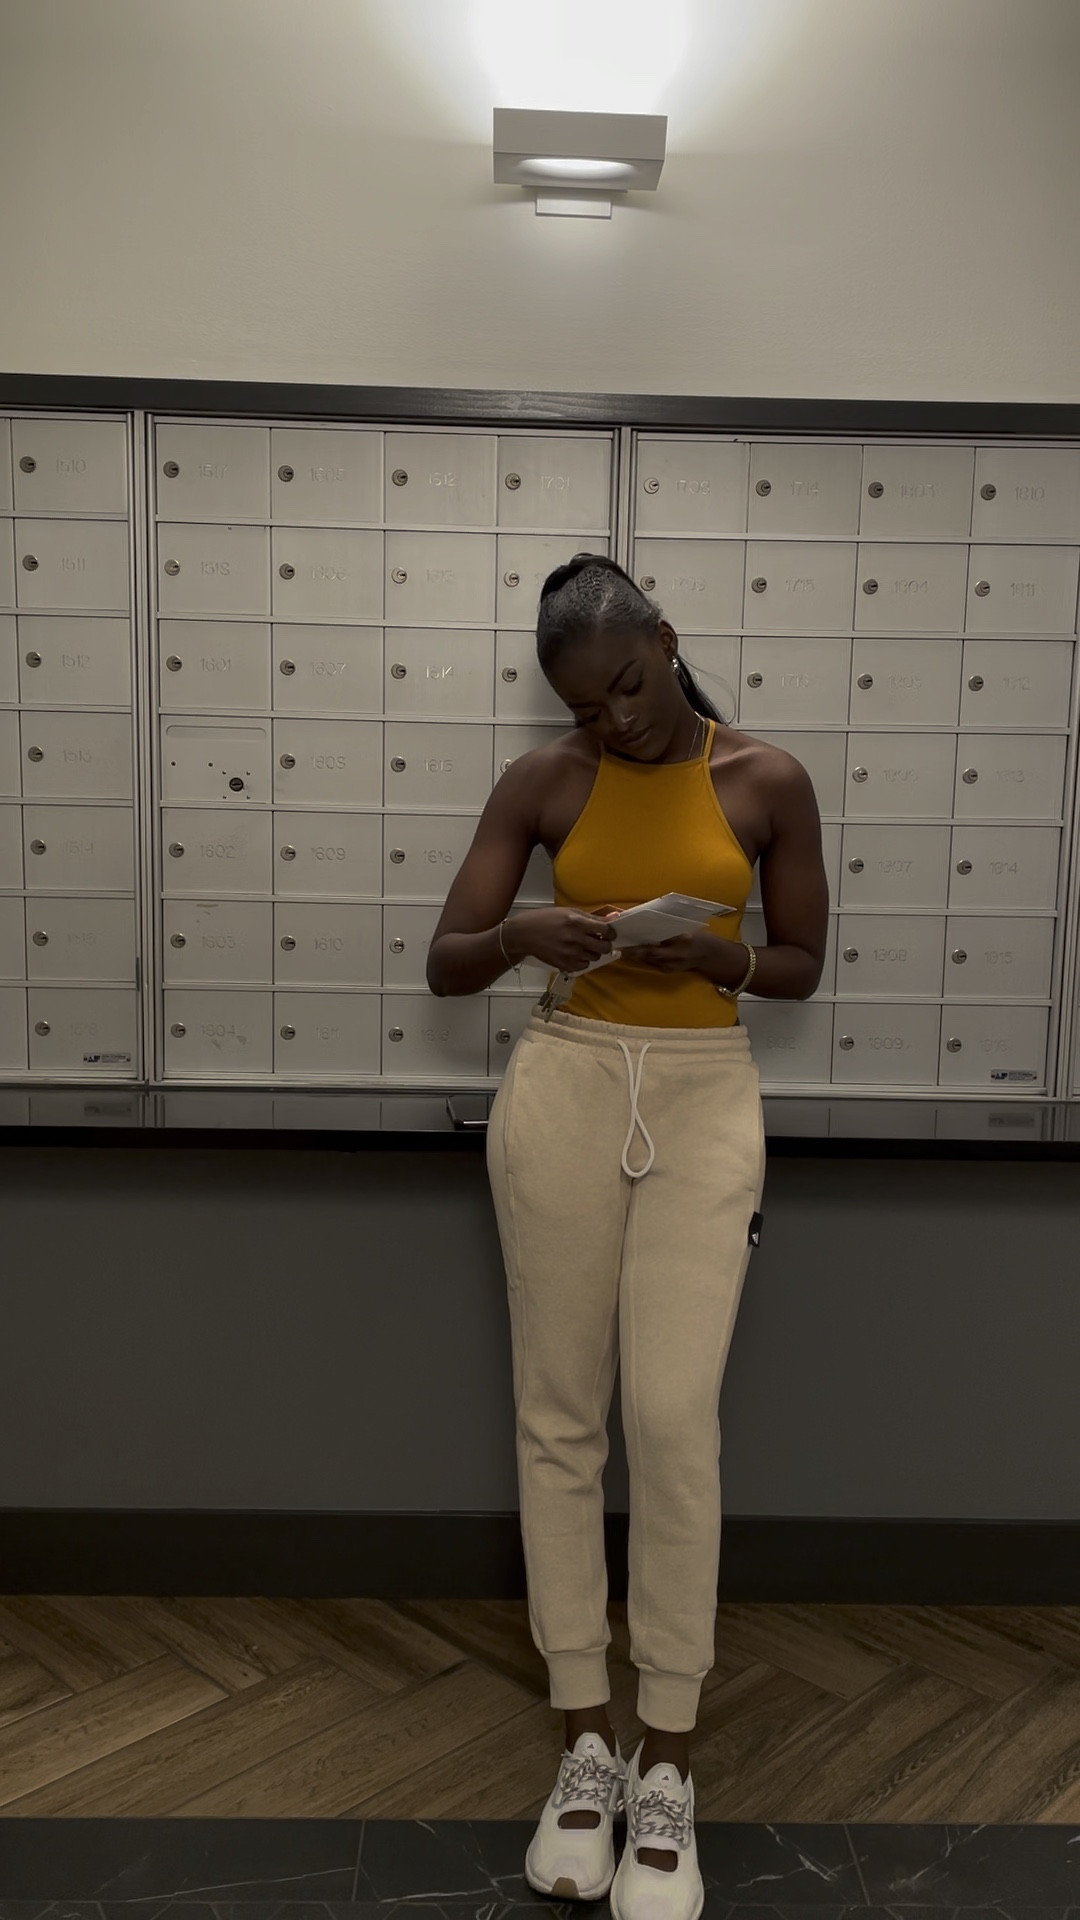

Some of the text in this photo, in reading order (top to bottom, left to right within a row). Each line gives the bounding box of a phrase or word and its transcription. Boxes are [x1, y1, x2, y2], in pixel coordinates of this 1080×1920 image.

[56, 457, 87, 474] 1510
[199, 463, 229, 479] 1517
[429, 472, 457, 487] 1612
[541, 475, 570, 491] 1701
[675, 479, 711, 496] 1708
[61, 556, 86, 572] 1511
[201, 561, 231, 576] 1518
[785, 577, 815, 593] 1715
[1010, 582, 1036, 598] 1811
[62, 654, 91, 669] 1512
[201, 657, 231, 673] 1601
[311, 661, 347, 675] 1607
[312, 755, 346, 770] 1608
[424, 759, 453, 773] 1615
[201, 844, 237, 859] 1602
[312, 847, 346, 862] 1609
[989, 862, 1018, 876] 1814
[202, 935, 236, 950] 1603
[314, 936, 344, 951] 1610
[873, 949, 907, 963] 1808
[984, 951, 1013, 965] 1815
[202, 1024, 236, 1038] 1604
[767, 1036, 796, 1050] 802
[868, 1036, 904, 1050] 1809
